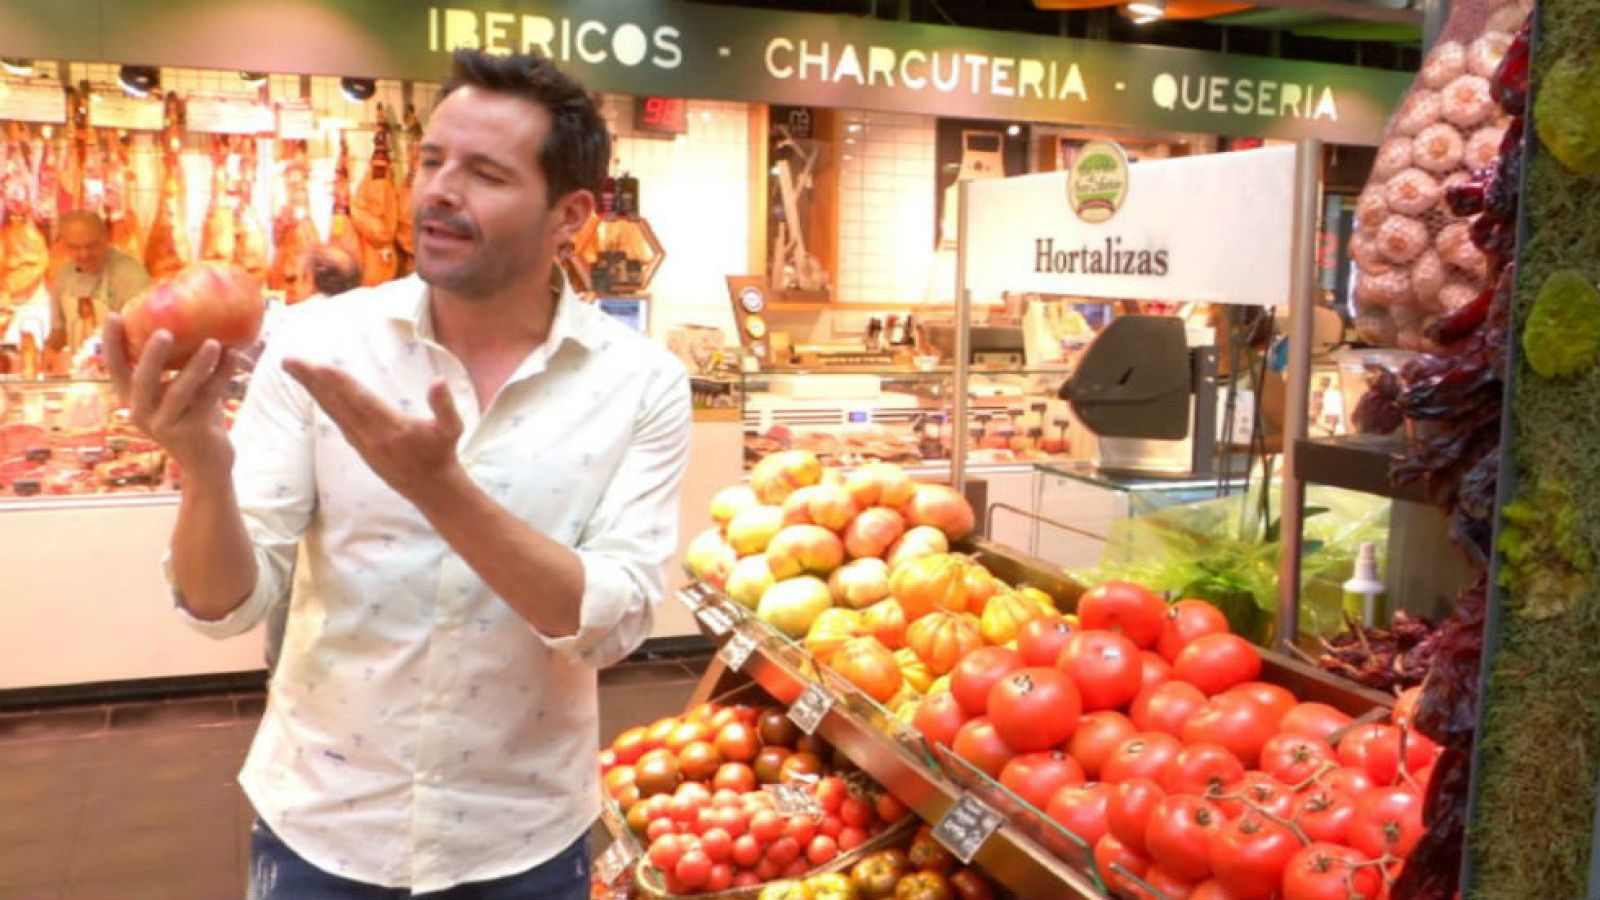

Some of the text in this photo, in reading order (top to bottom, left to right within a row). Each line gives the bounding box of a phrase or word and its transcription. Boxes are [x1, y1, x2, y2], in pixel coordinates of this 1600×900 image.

[428, 8, 682, 69] IBERICOS
[765, 38, 1088, 101] CHARCUTERIA
[1152, 72, 1338, 121] QUESERIA
[1034, 236, 1169, 276] Hortalizas
